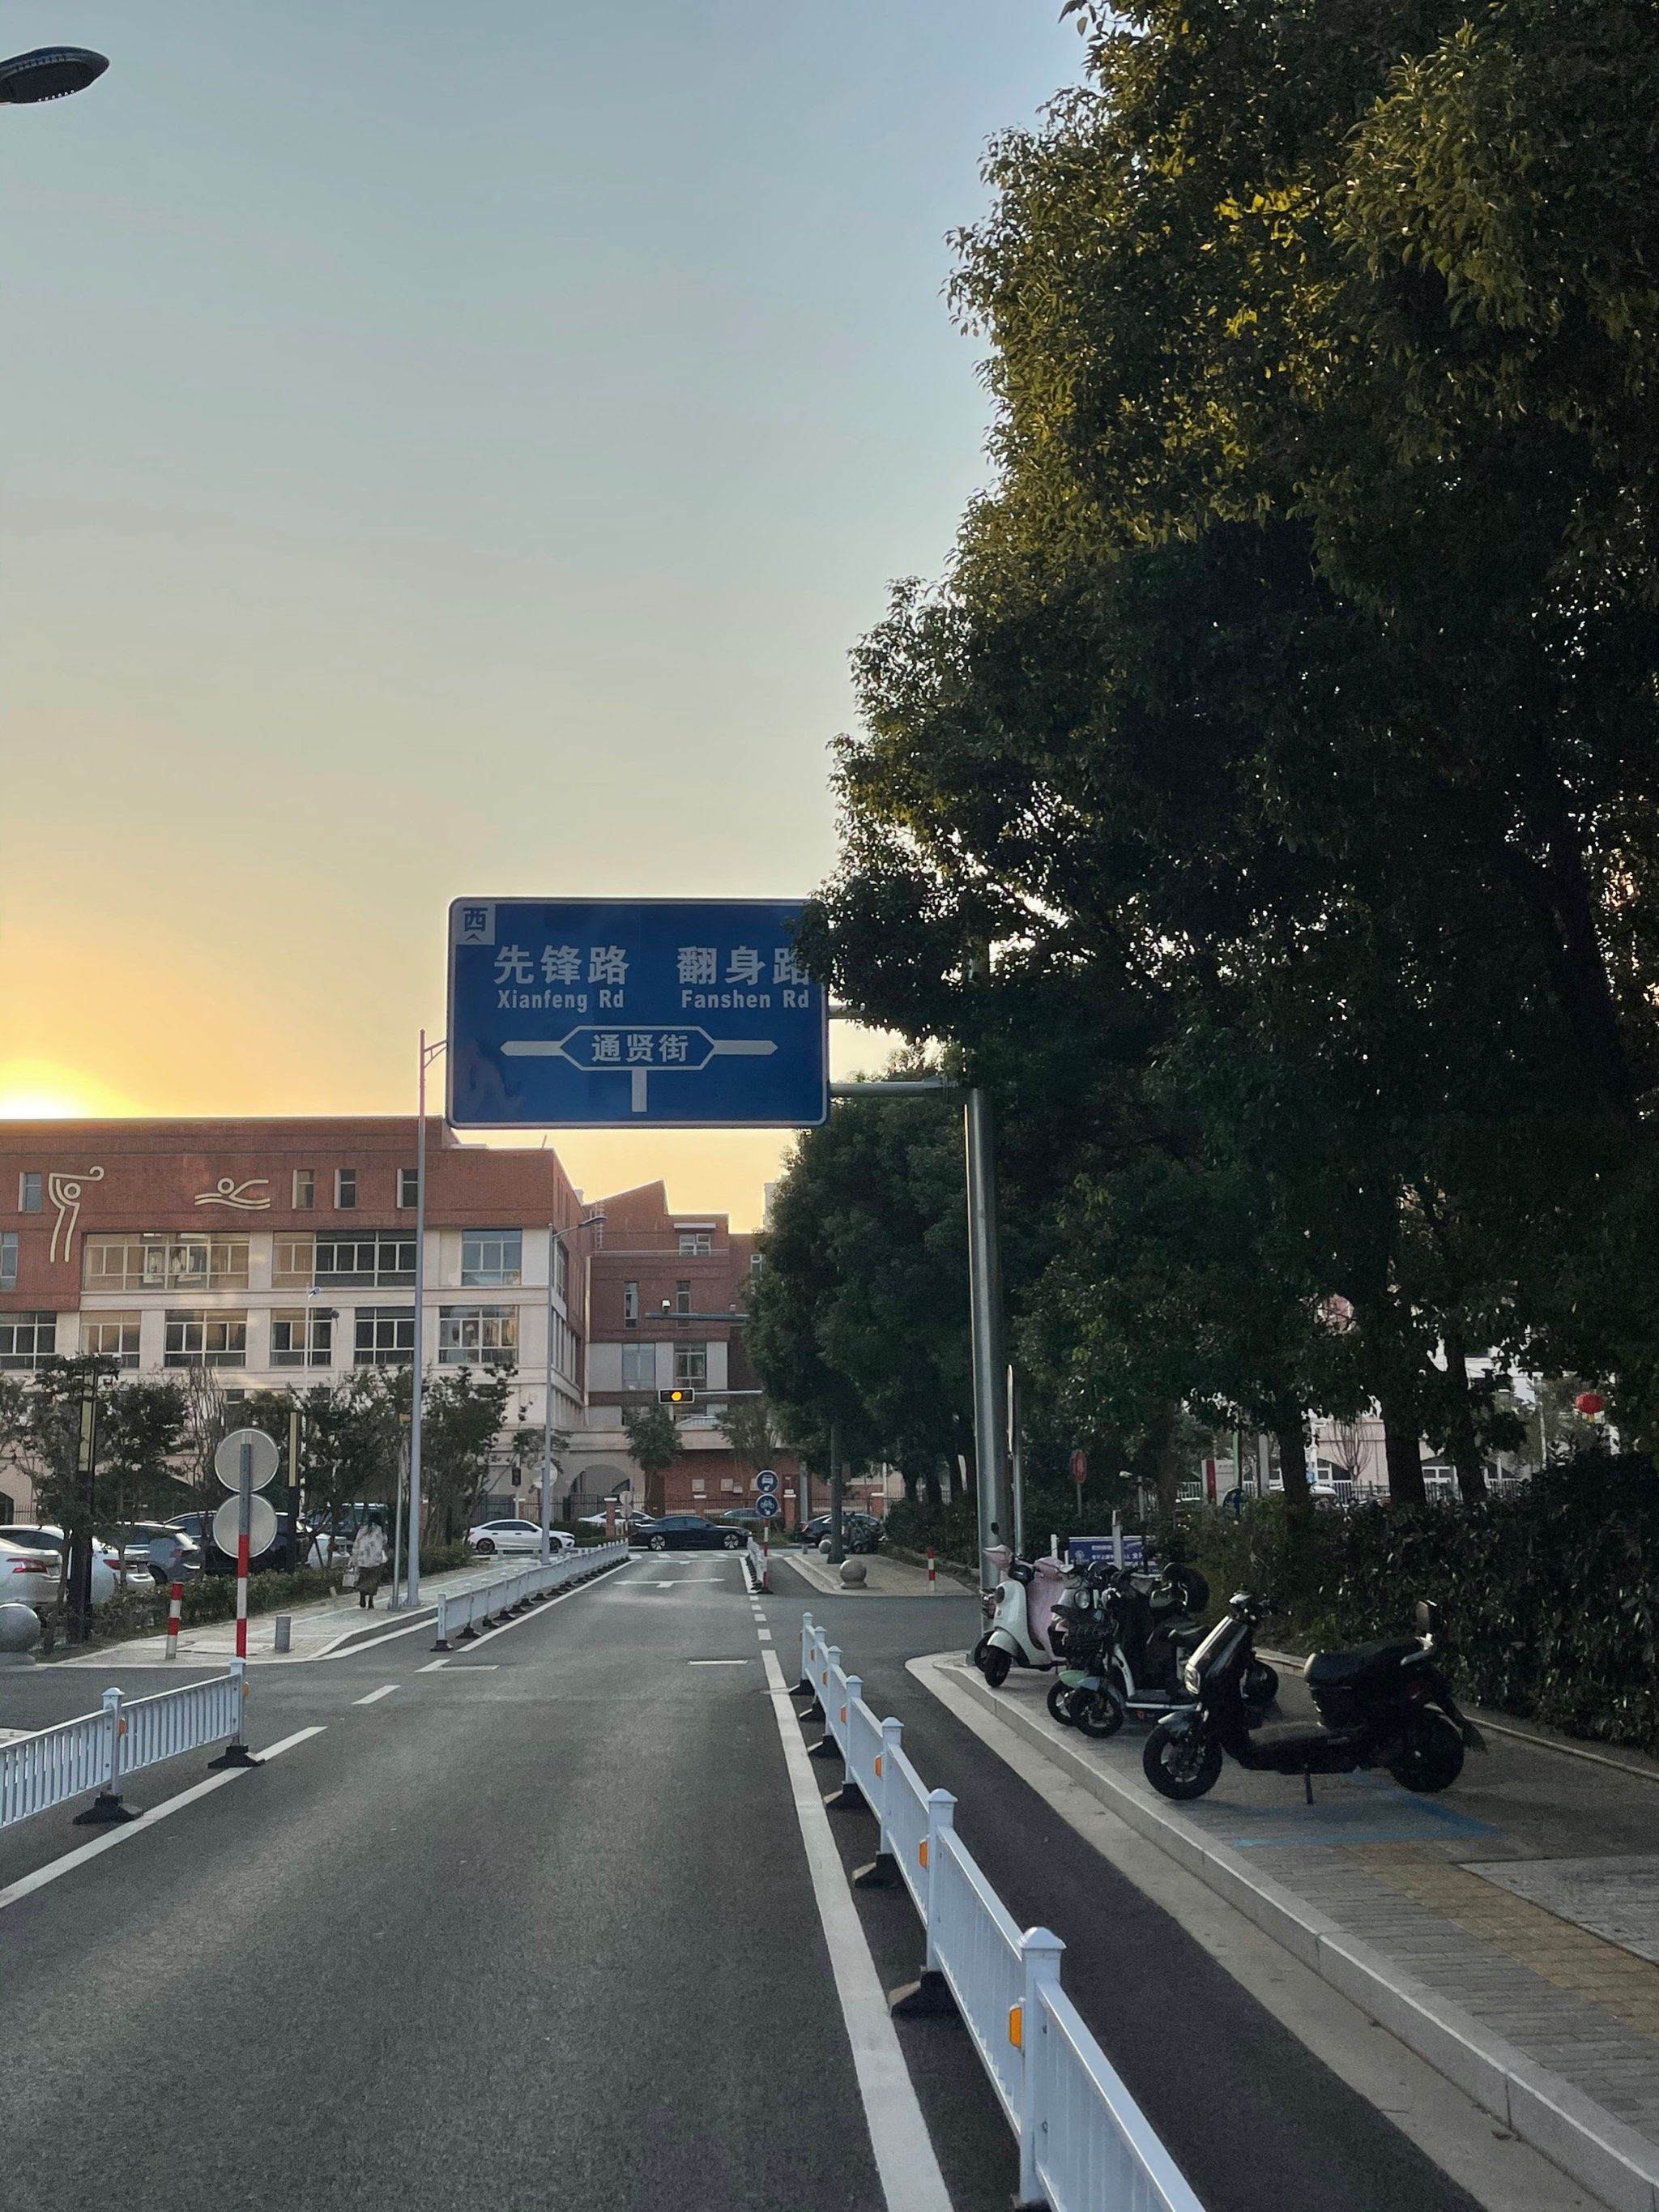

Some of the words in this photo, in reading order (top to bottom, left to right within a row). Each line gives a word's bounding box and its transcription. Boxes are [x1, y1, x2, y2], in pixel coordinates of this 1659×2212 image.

[463, 907, 488, 933] 西
[493, 945, 629, 985] 先锋路
[676, 946, 811, 985] 翻身路
[497, 989, 588, 1013] Xianfeng
[599, 989, 625, 1009] Rd
[681, 989, 771, 1009] Fanshen
[783, 989, 809, 1008] Rd
[591, 1033, 689, 1063] 通贤街
